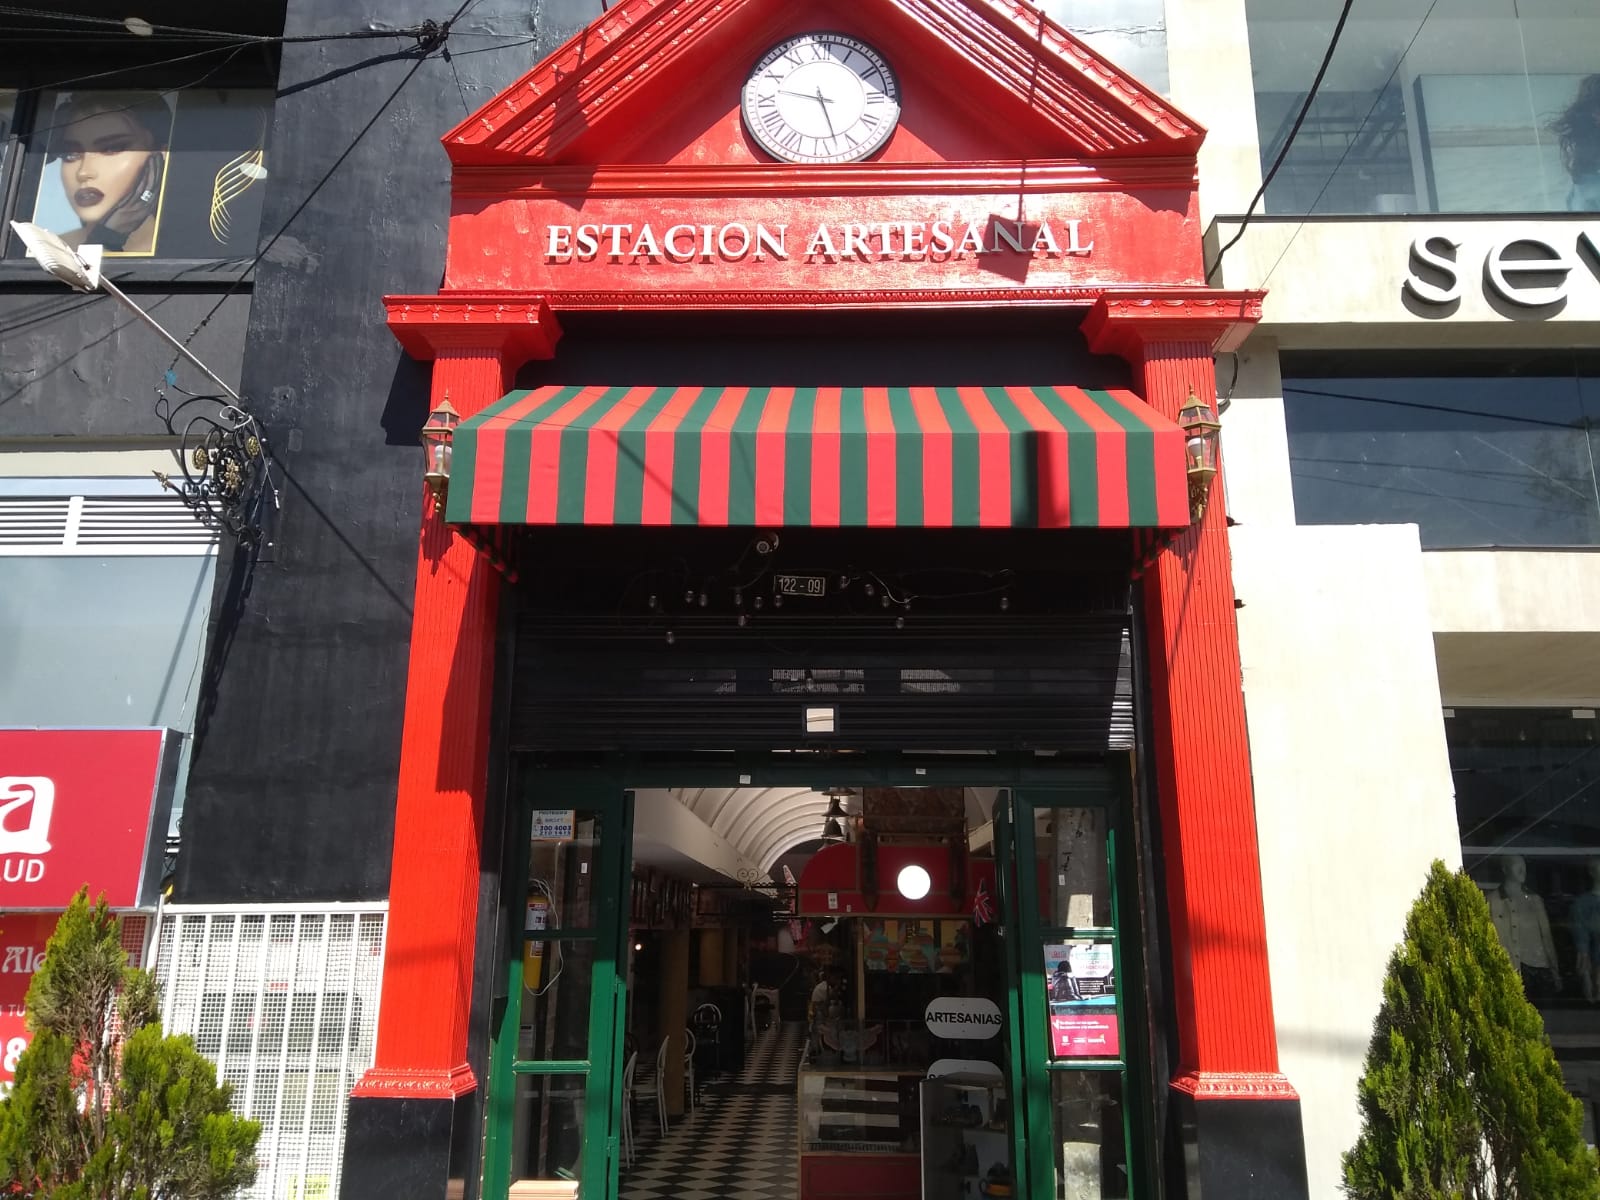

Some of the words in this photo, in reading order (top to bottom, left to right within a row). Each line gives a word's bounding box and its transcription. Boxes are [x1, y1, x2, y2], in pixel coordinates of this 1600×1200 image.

[544, 222, 790, 258] ESTACION
[803, 218, 1095, 255] ARTESANAL
[1401, 231, 1600, 311] se
[778, 577, 797, 592] 122
[807, 579, 821, 593] 09
[0, 858, 45, 883] UD
[926, 1011, 1002, 1025] ARTESANIAS
